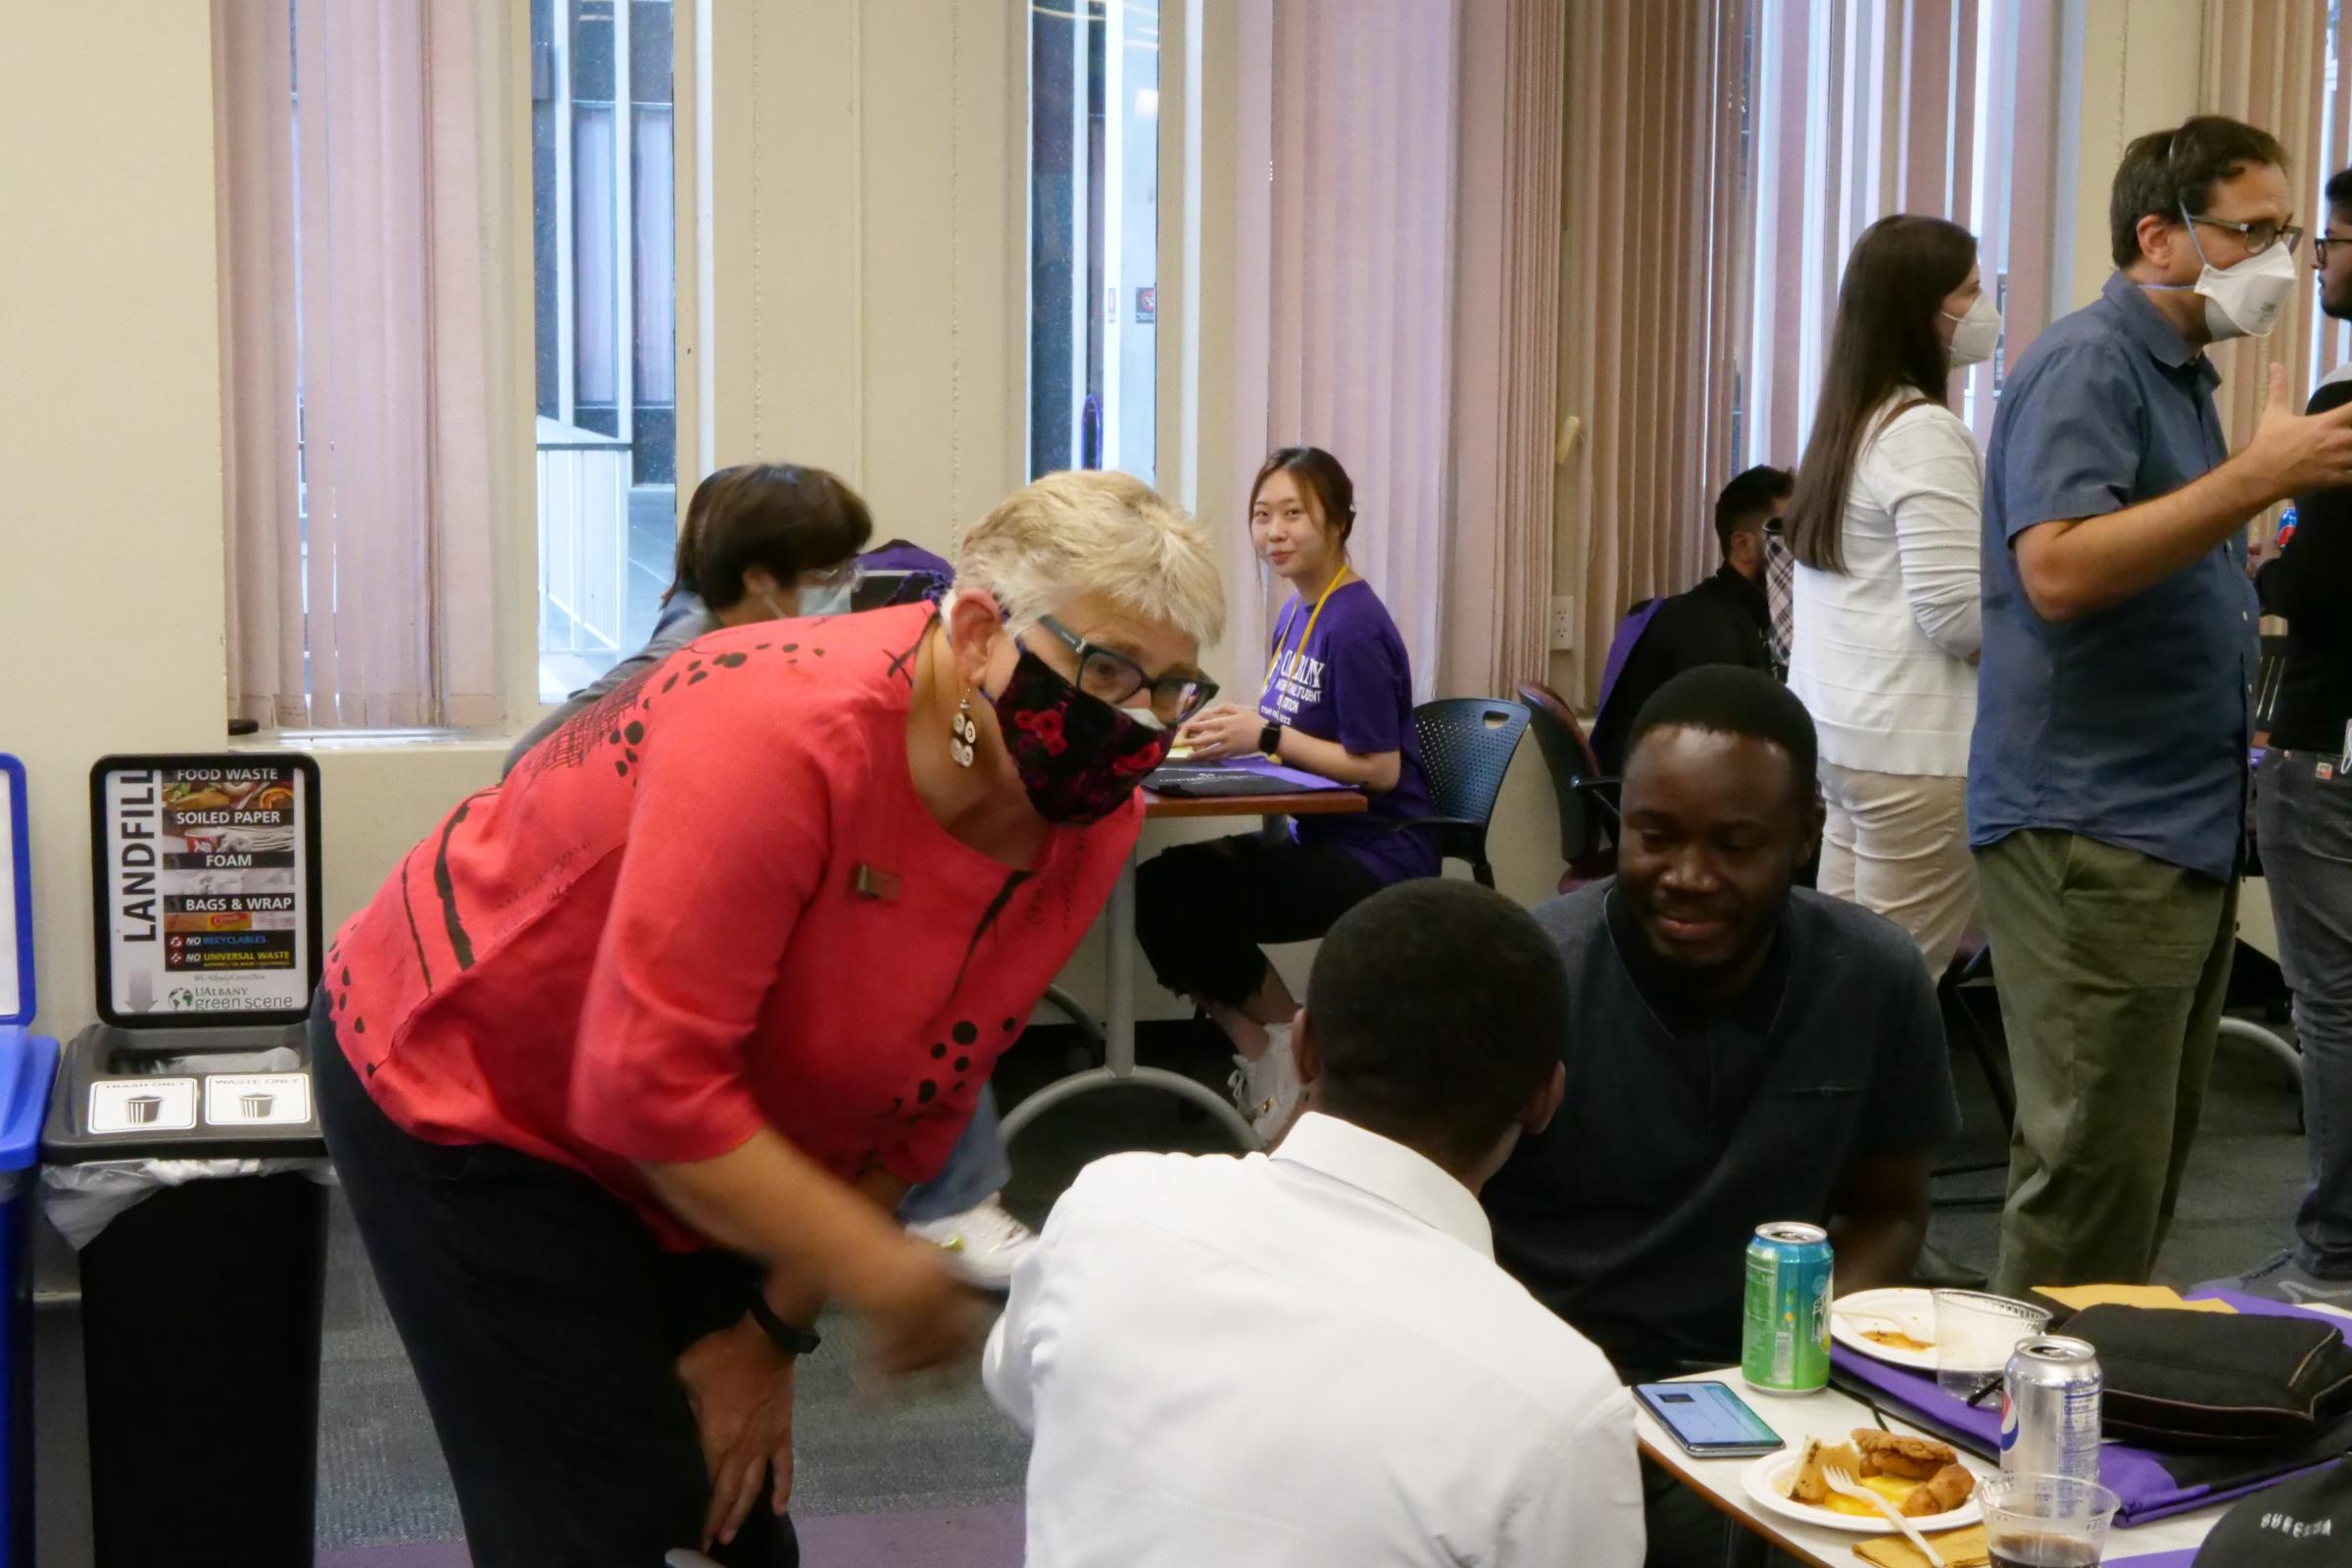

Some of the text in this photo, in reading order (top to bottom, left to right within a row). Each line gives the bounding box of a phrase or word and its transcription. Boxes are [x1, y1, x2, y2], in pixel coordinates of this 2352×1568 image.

[177, 767, 278, 780] FOOD WASTE
[176, 811, 280, 824] SOILED PAPER
[121, 769, 156, 942] LANDFILL
[206, 855, 252, 866] FOAM
[185, 898, 292, 910] BAGS & WRAP
[185, 935, 267, 946] NO RECYCLABLES
[185, 951, 290, 962] NO UNIVERSAL WASTE
[195, 996, 293, 1010] green scene
